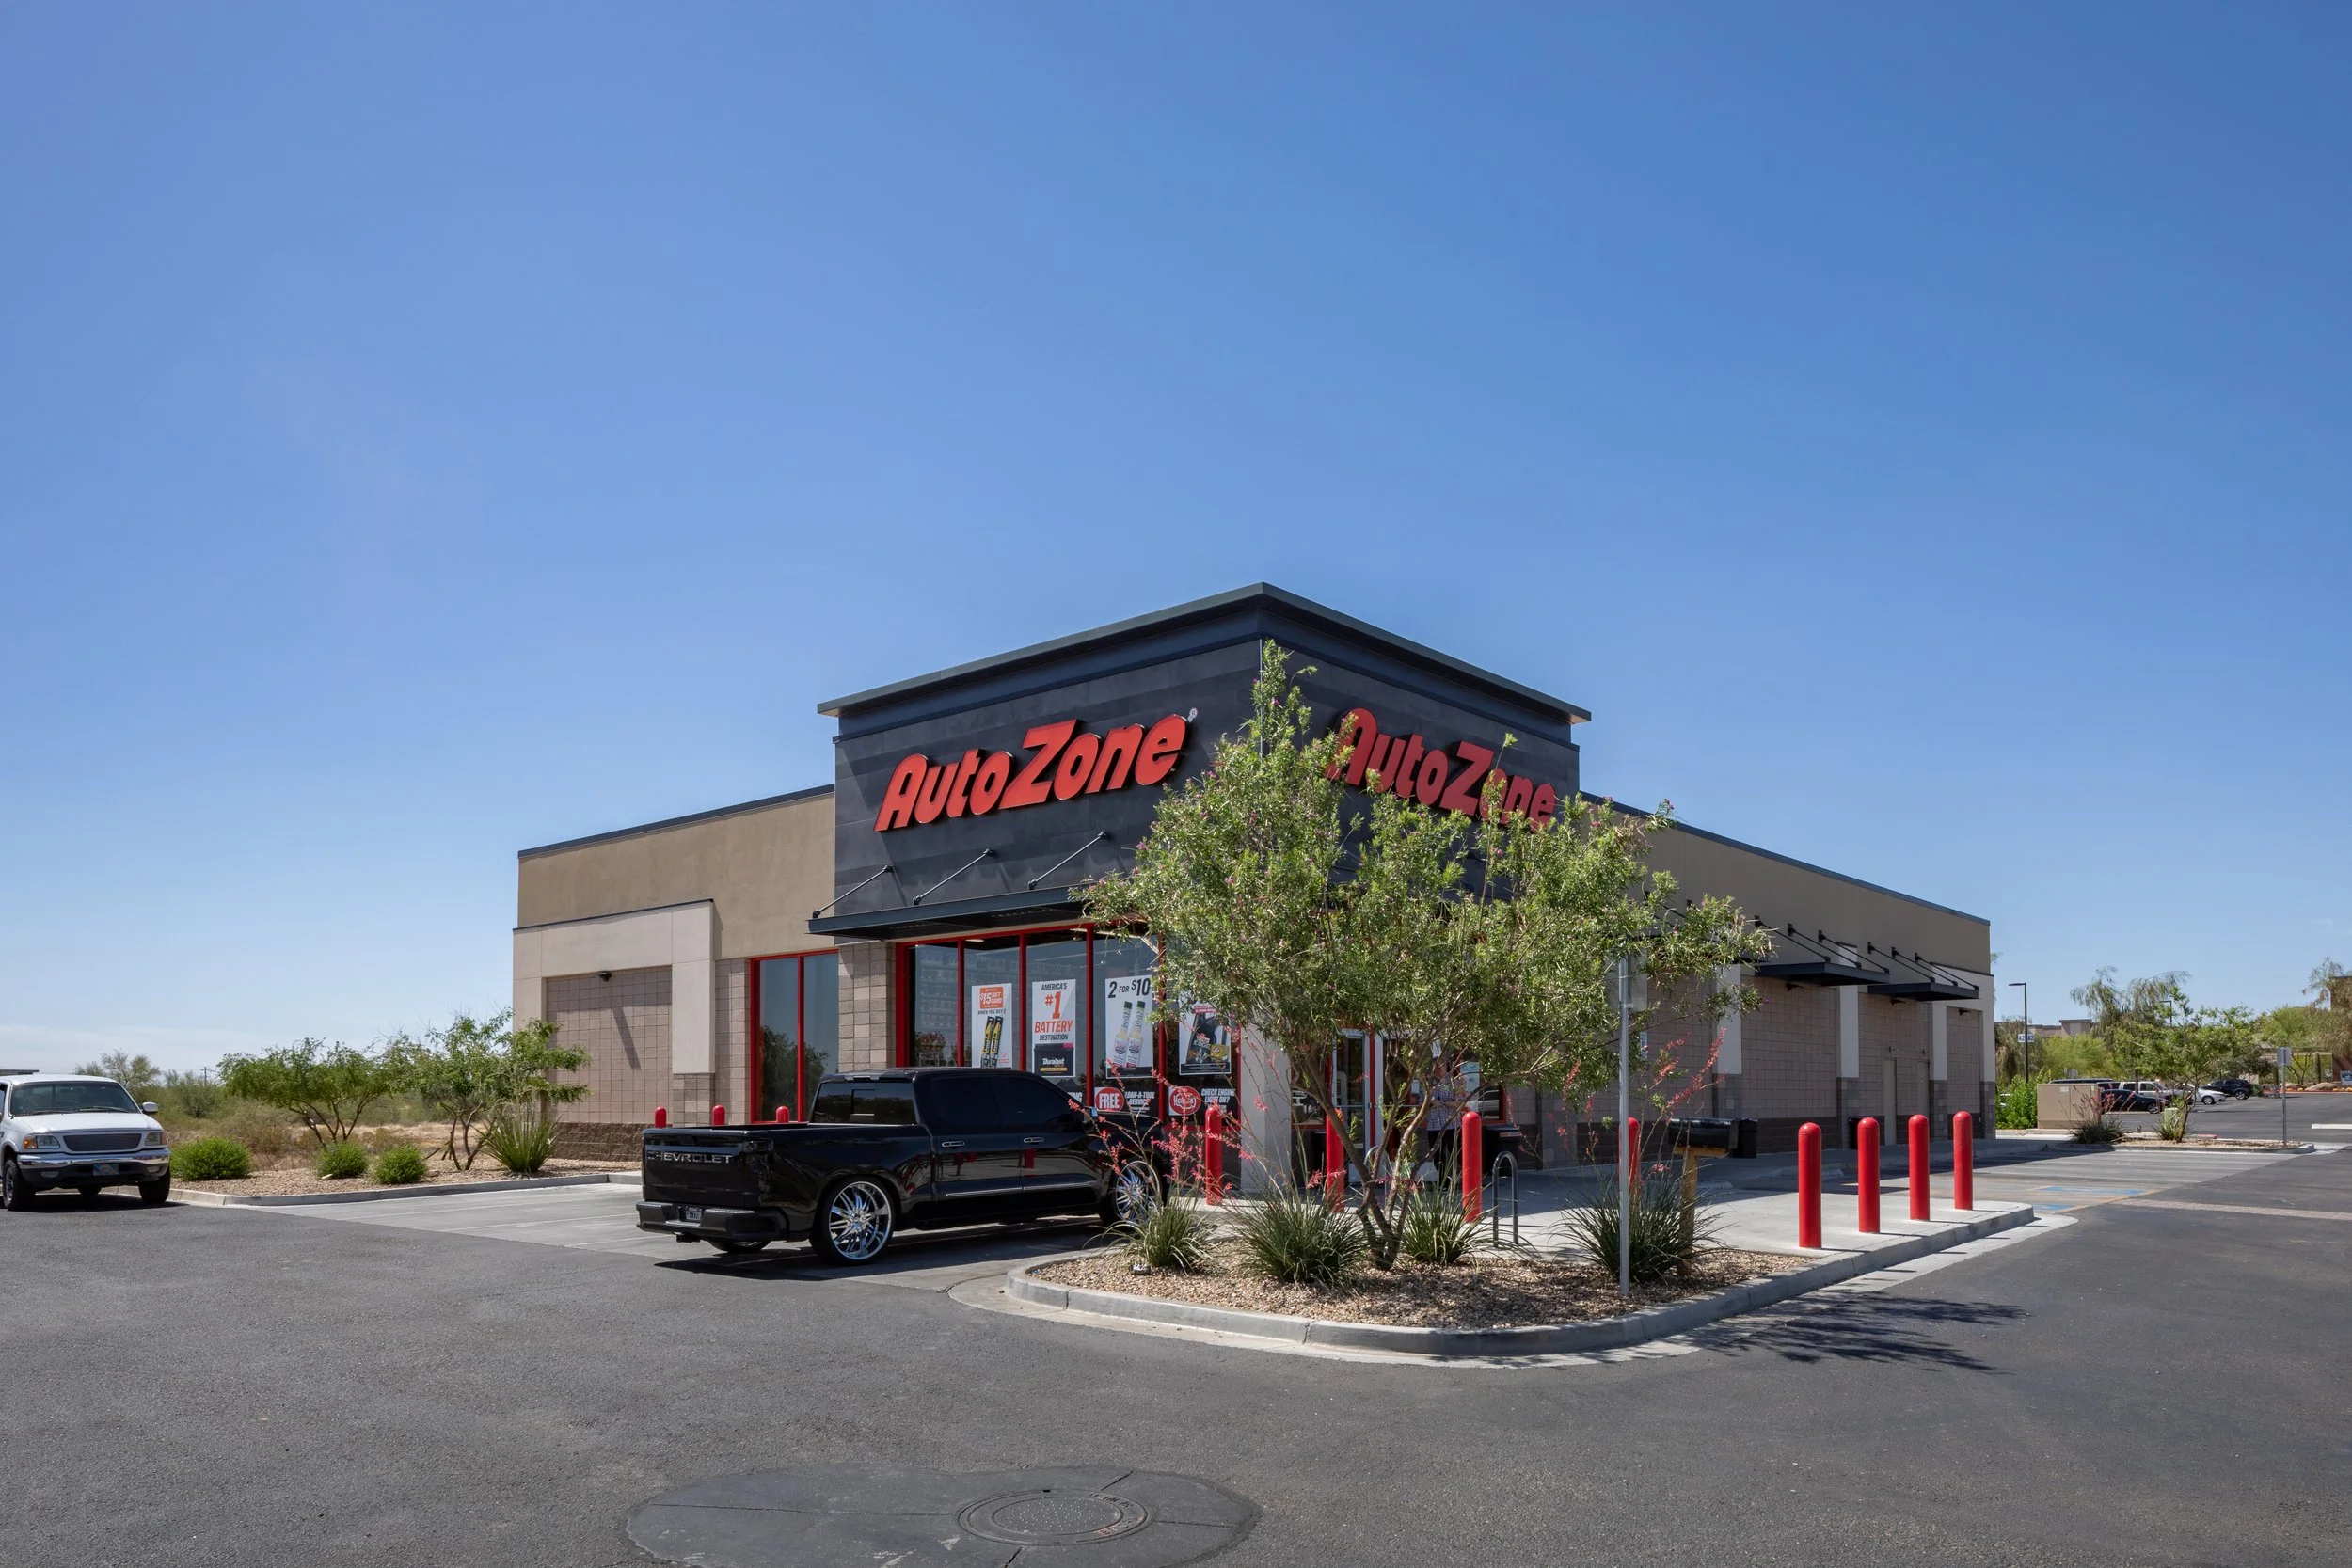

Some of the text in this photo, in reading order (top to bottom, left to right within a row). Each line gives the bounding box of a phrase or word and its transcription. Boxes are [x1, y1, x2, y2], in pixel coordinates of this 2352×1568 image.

[873, 713, 1189, 832] AutoZone
[1324, 707, 1557, 833] AutoZone
[1041, 982, 1068, 990] AMERICA'S
[1107, 978, 1151, 998] 2 FOR $10
[1044, 991, 1061, 1019] #1
[1034, 1021, 1073, 1033] BATTERY
[1099, 1093, 1120, 1108] FREE
